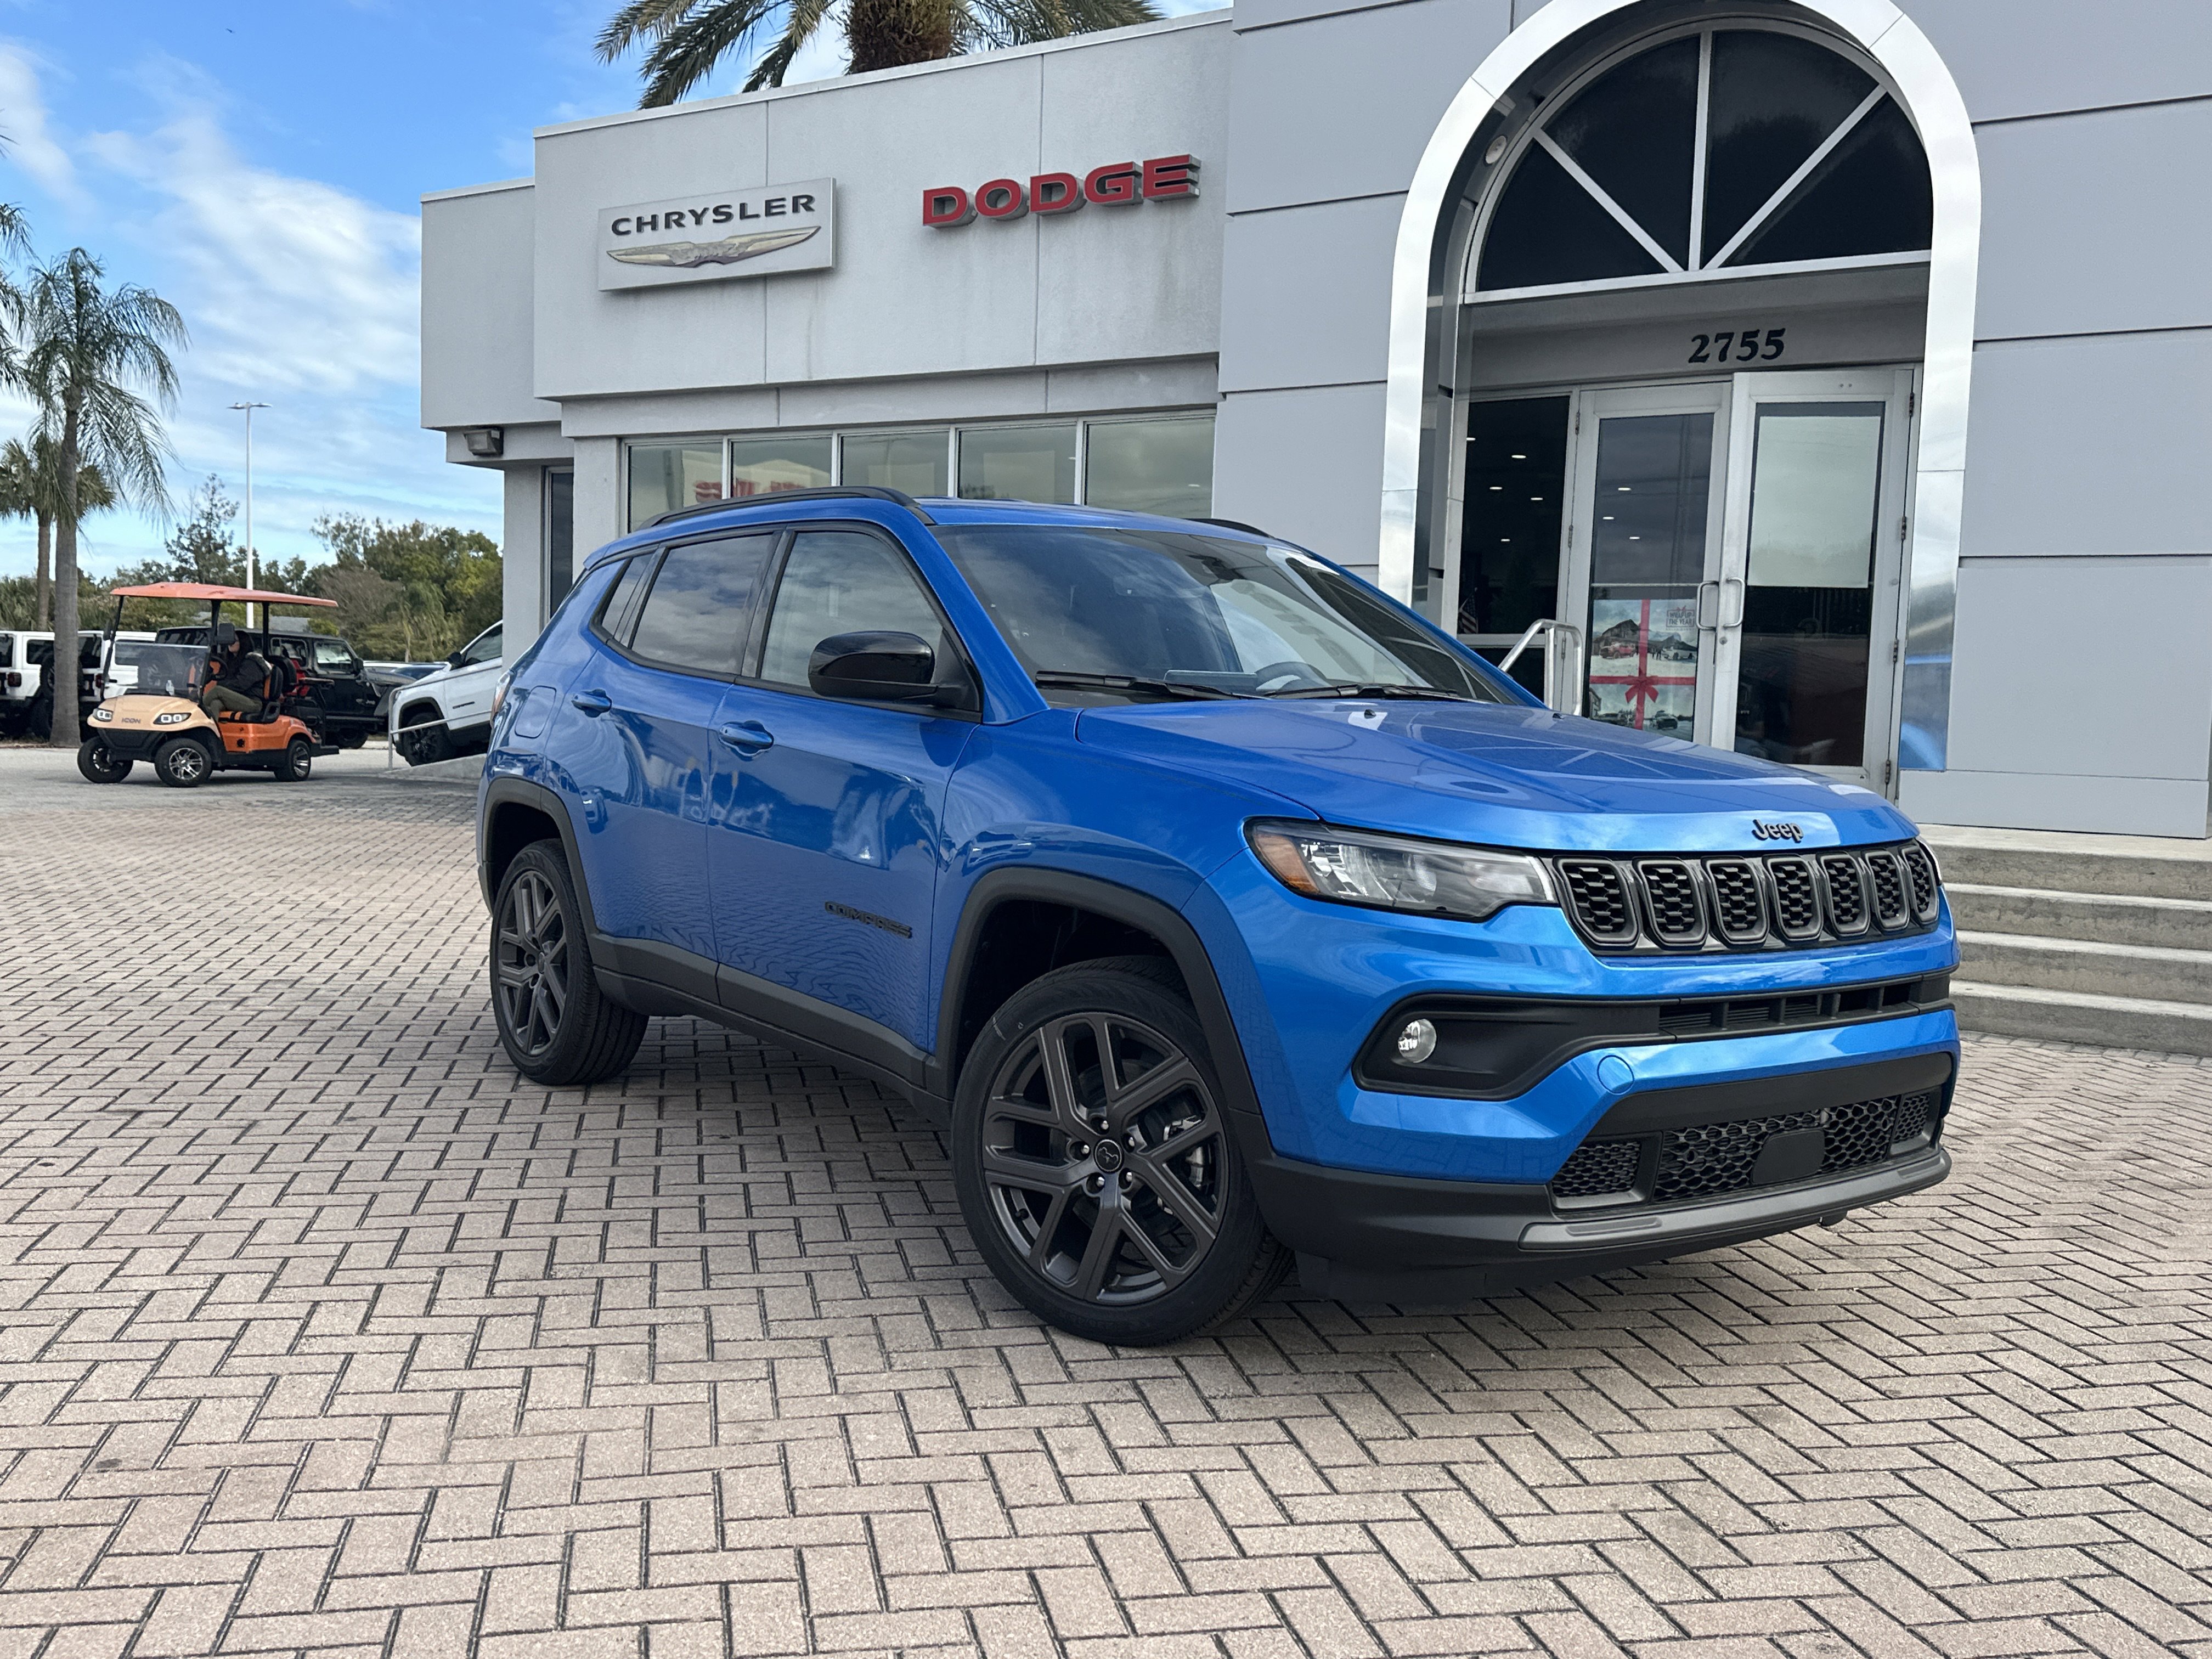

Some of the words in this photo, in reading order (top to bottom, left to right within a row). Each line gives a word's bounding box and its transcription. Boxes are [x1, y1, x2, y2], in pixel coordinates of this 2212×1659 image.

[923, 154, 1202, 228] DODGE
[611, 194, 816, 236] CHRYSLER
[1688, 328, 1786, 363] 2755
[1752, 819, 1804, 843] Jeep
